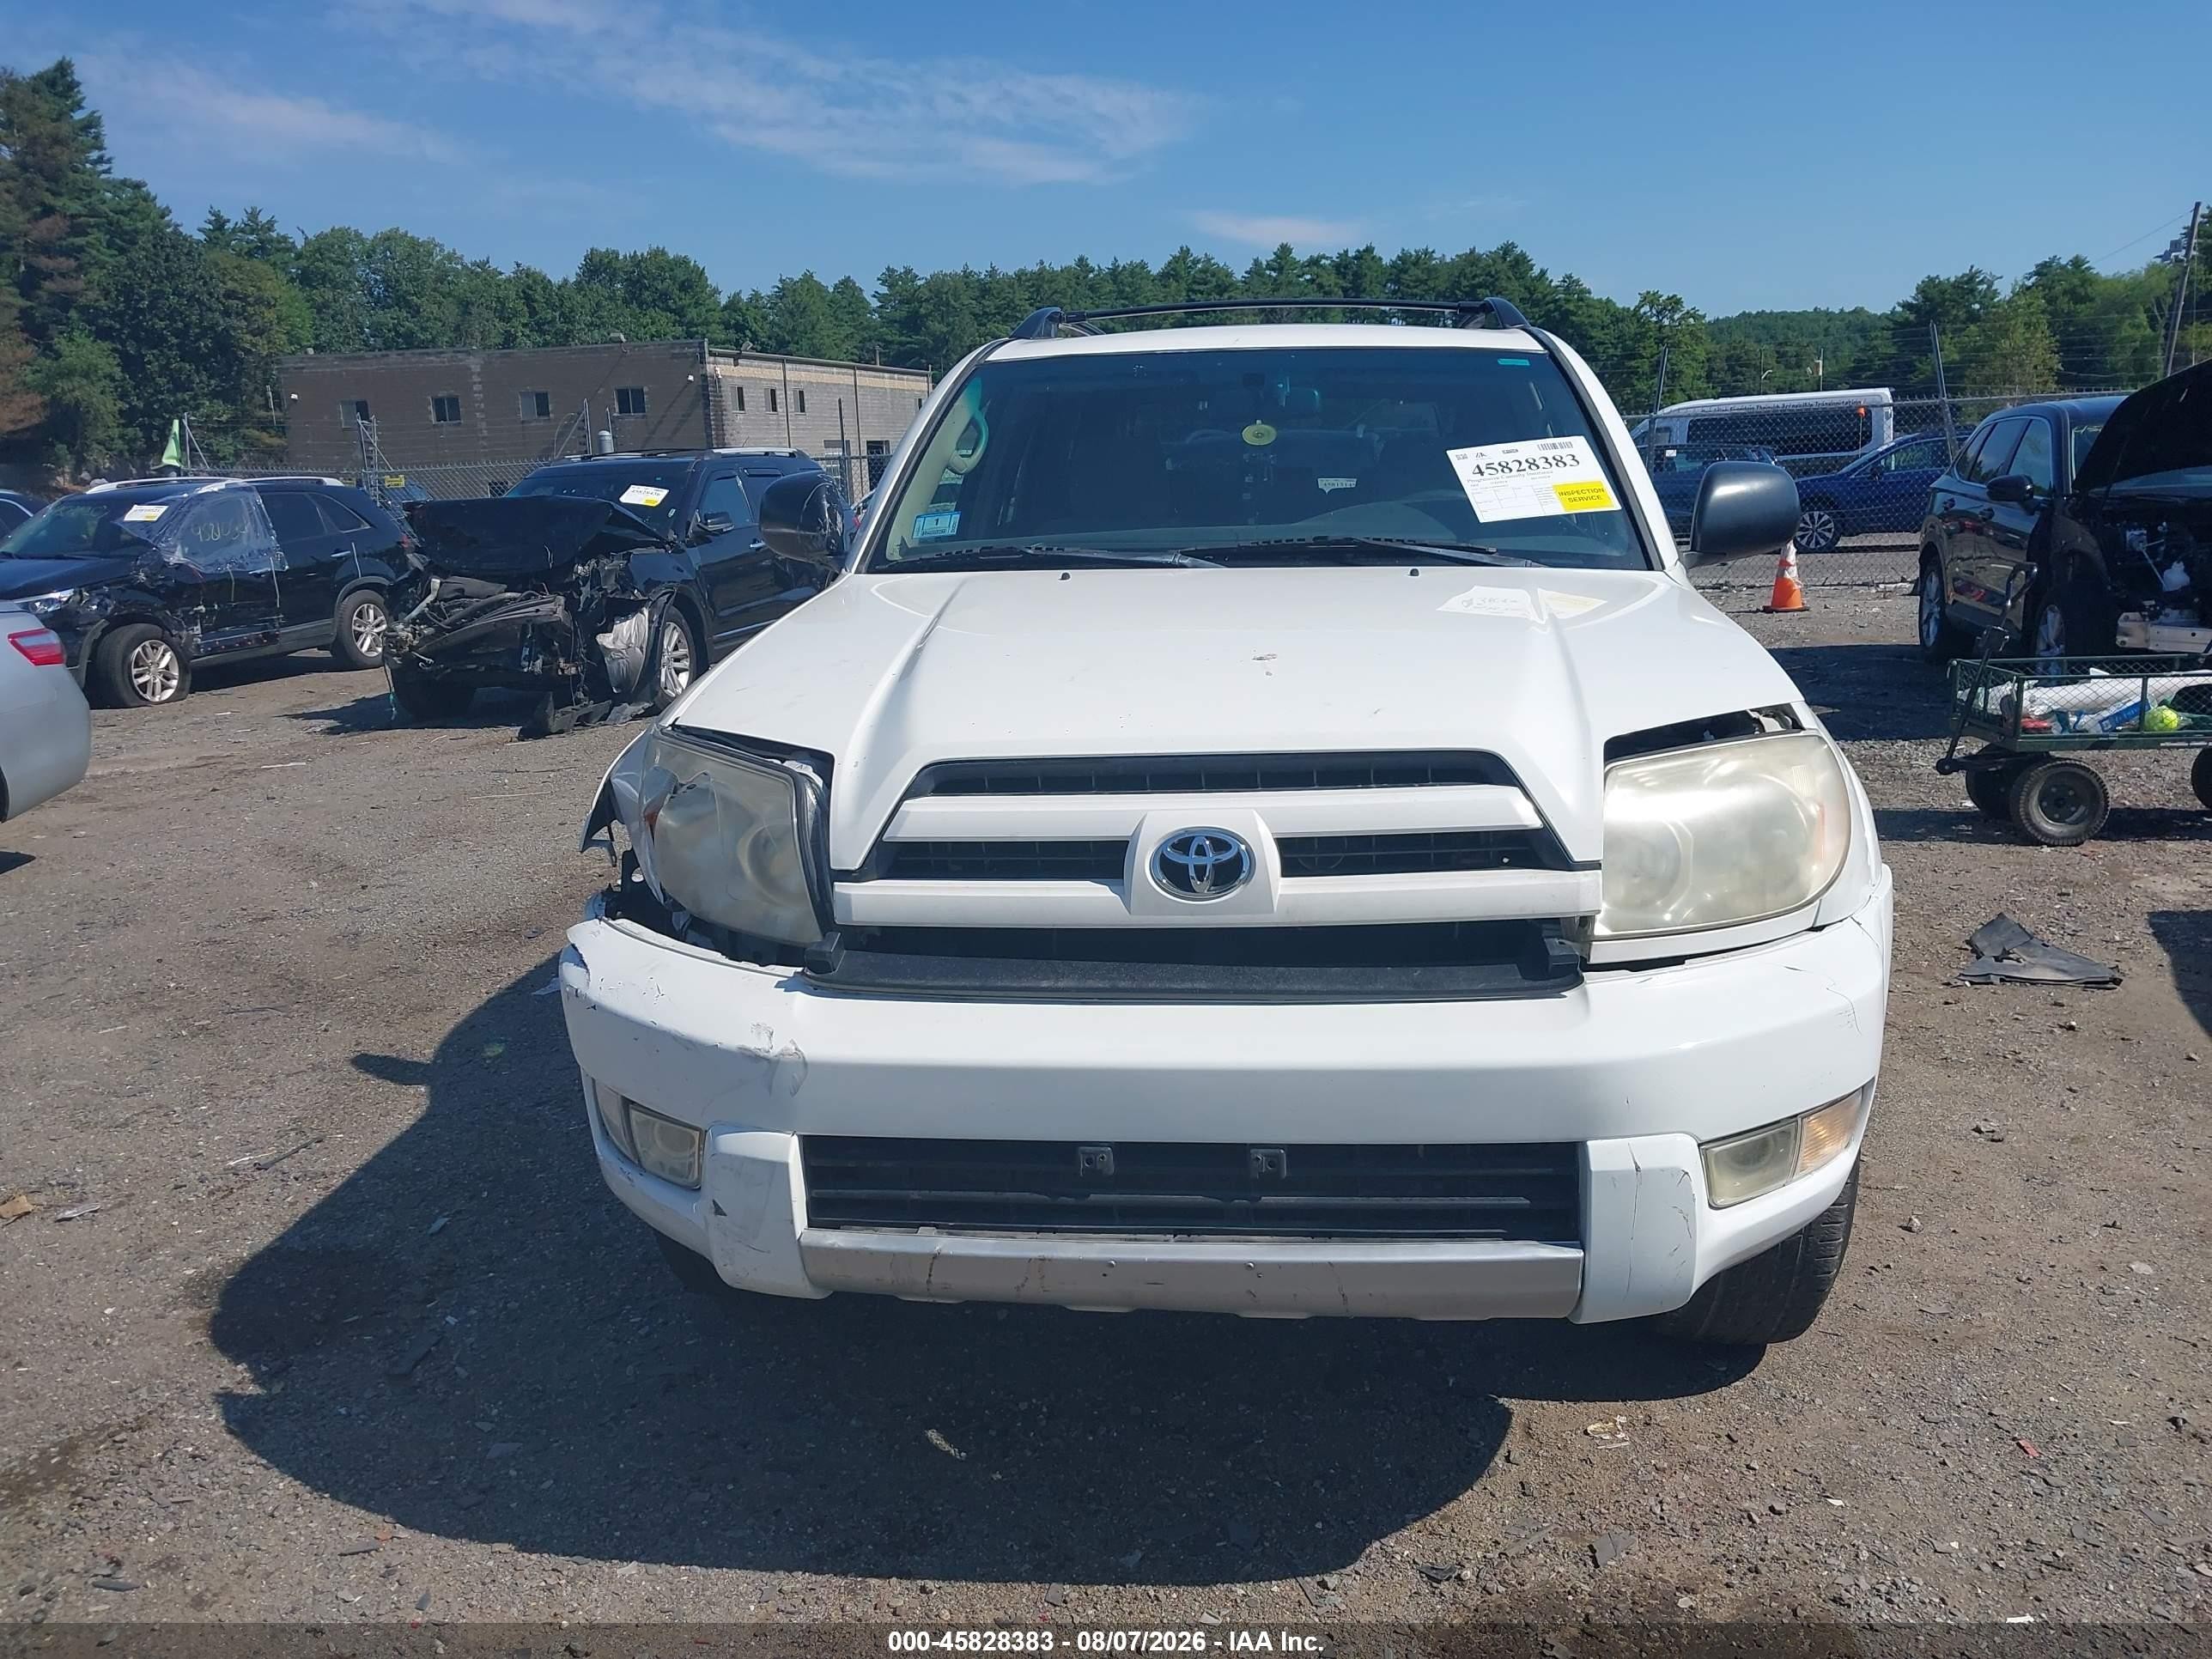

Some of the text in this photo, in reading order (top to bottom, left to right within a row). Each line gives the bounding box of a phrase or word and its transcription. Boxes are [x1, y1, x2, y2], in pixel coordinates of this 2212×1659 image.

[1472, 453, 1580, 476] 45828383
[1558, 487, 1605, 496] INSPECTION
[1567, 495, 1601, 503] SERVICE
